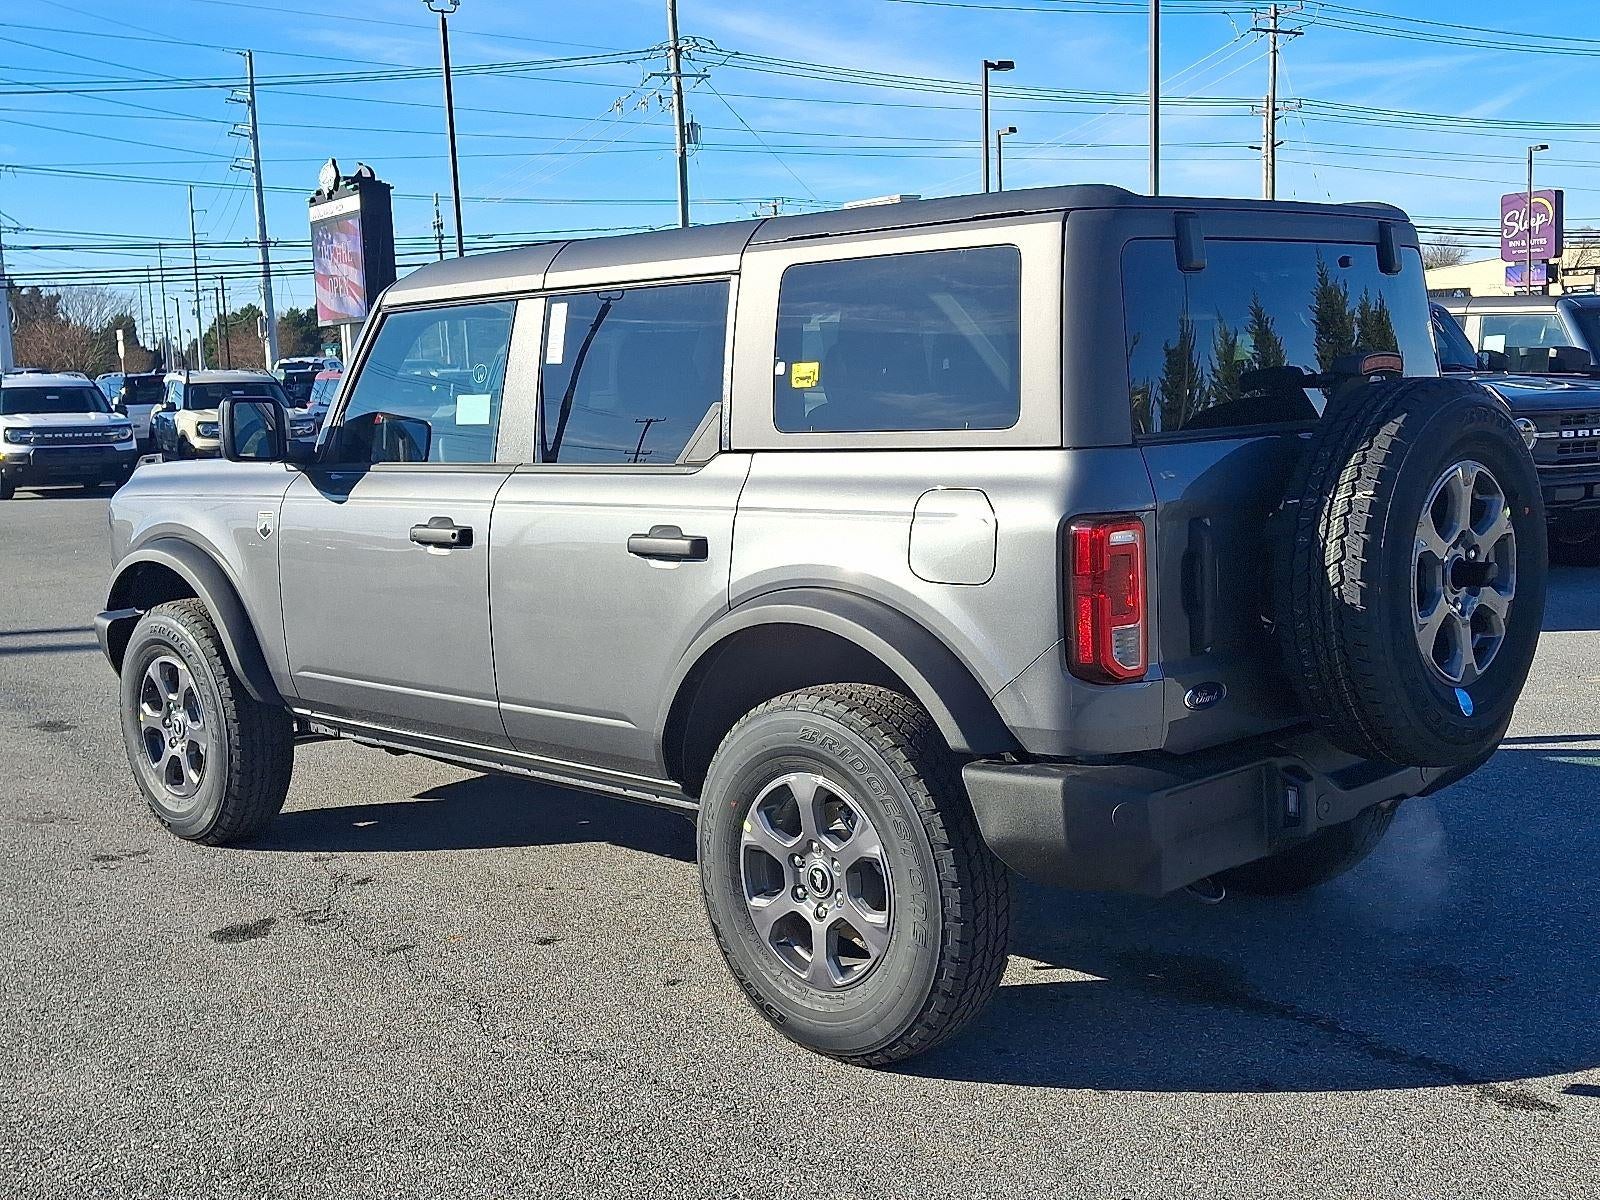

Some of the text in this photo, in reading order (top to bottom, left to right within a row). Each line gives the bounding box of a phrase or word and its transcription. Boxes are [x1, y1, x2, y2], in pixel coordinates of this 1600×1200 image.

[1530, 238, 1547, 246] UITES
[328, 276, 350, 299] OPEN
[797, 726, 929, 949] BRIDGESTONE
